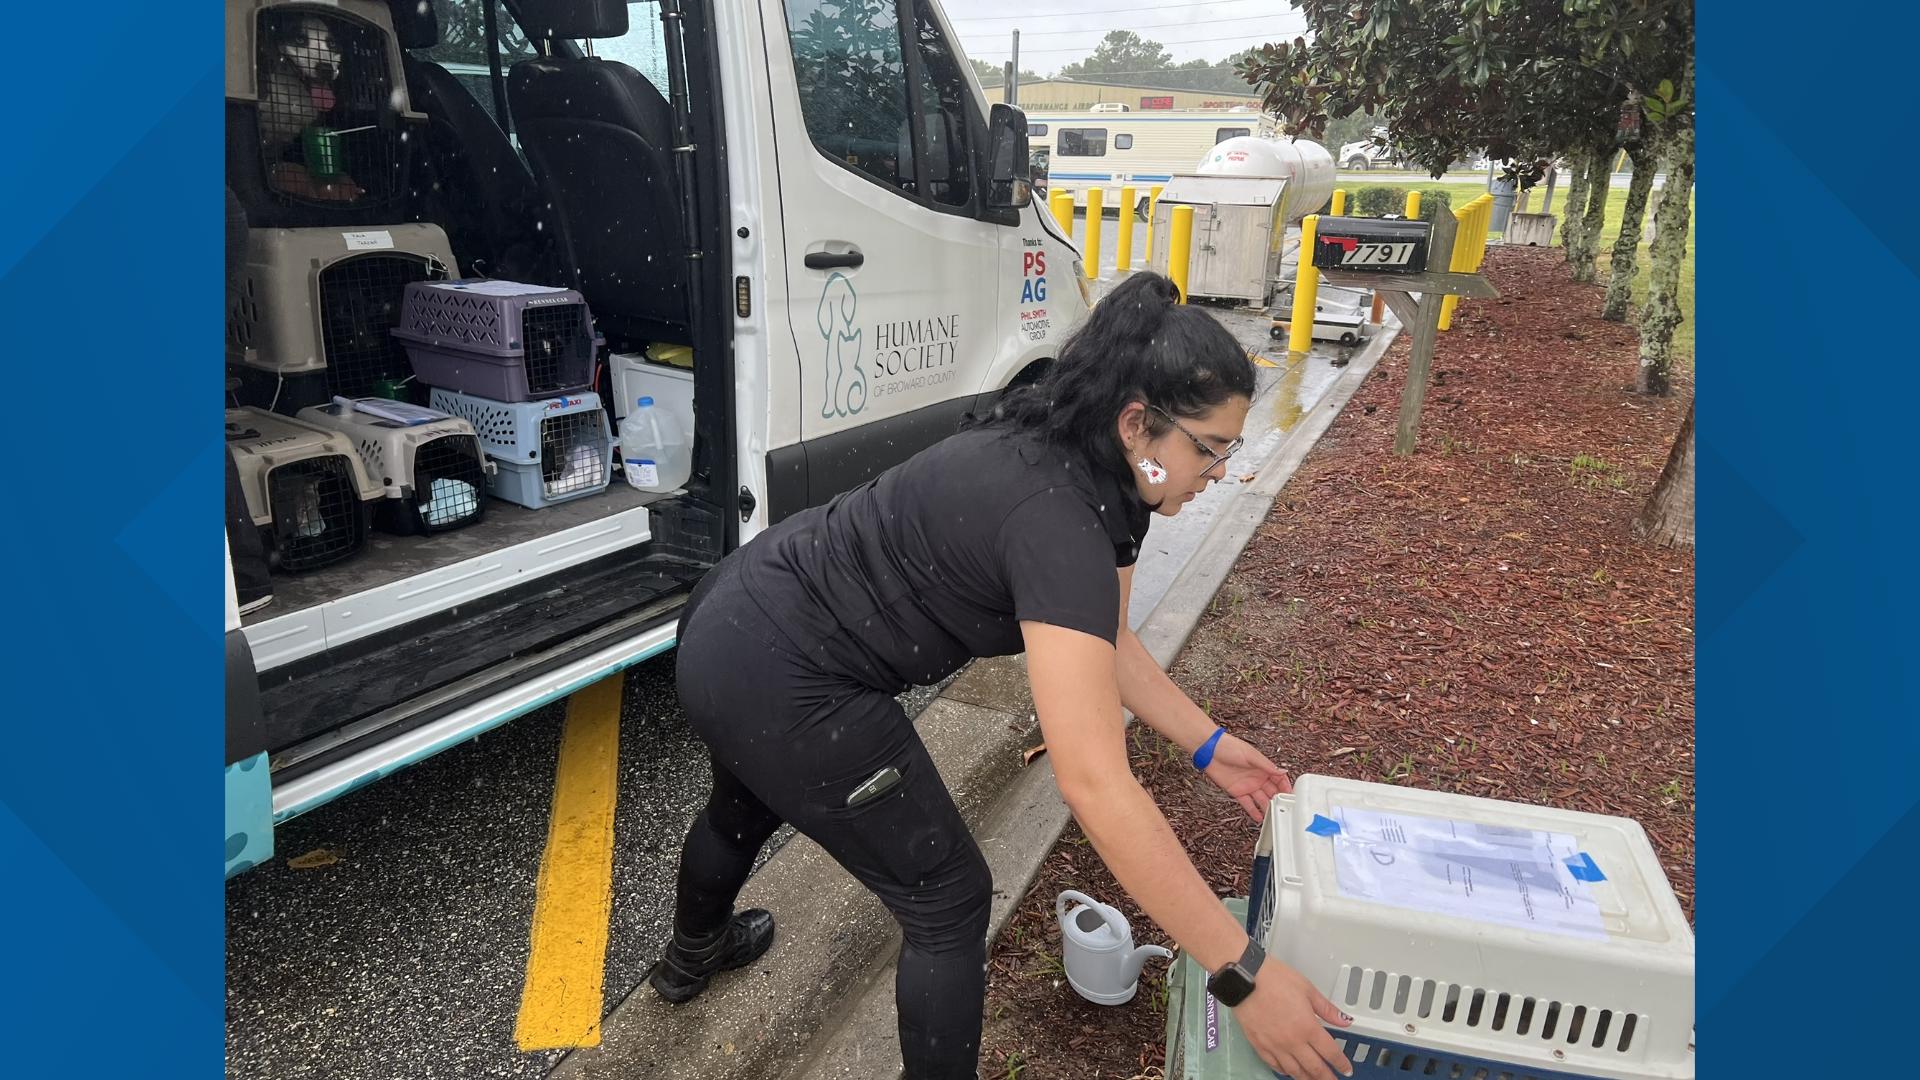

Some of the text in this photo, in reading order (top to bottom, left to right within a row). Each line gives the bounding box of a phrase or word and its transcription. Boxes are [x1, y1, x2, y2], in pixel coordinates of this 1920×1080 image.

[1022, 238, 1037, 246] Thanks
[1023, 251, 1046, 277] PS
[1346, 245, 1408, 263] 7791
[1020, 277, 1046, 304] AG
[1020, 309, 1047, 321] PHIL SMITH
[1021, 319, 1051, 331] AUTOMOTIVE
[876, 314, 960, 350] HUMANE
[1029, 330, 1046, 341] GROUP
[875, 340, 958, 379] SOCIETY
[874, 370, 957, 398] OF BROWARD COUNTY
[1207, 1027, 1216, 1048] CAB
